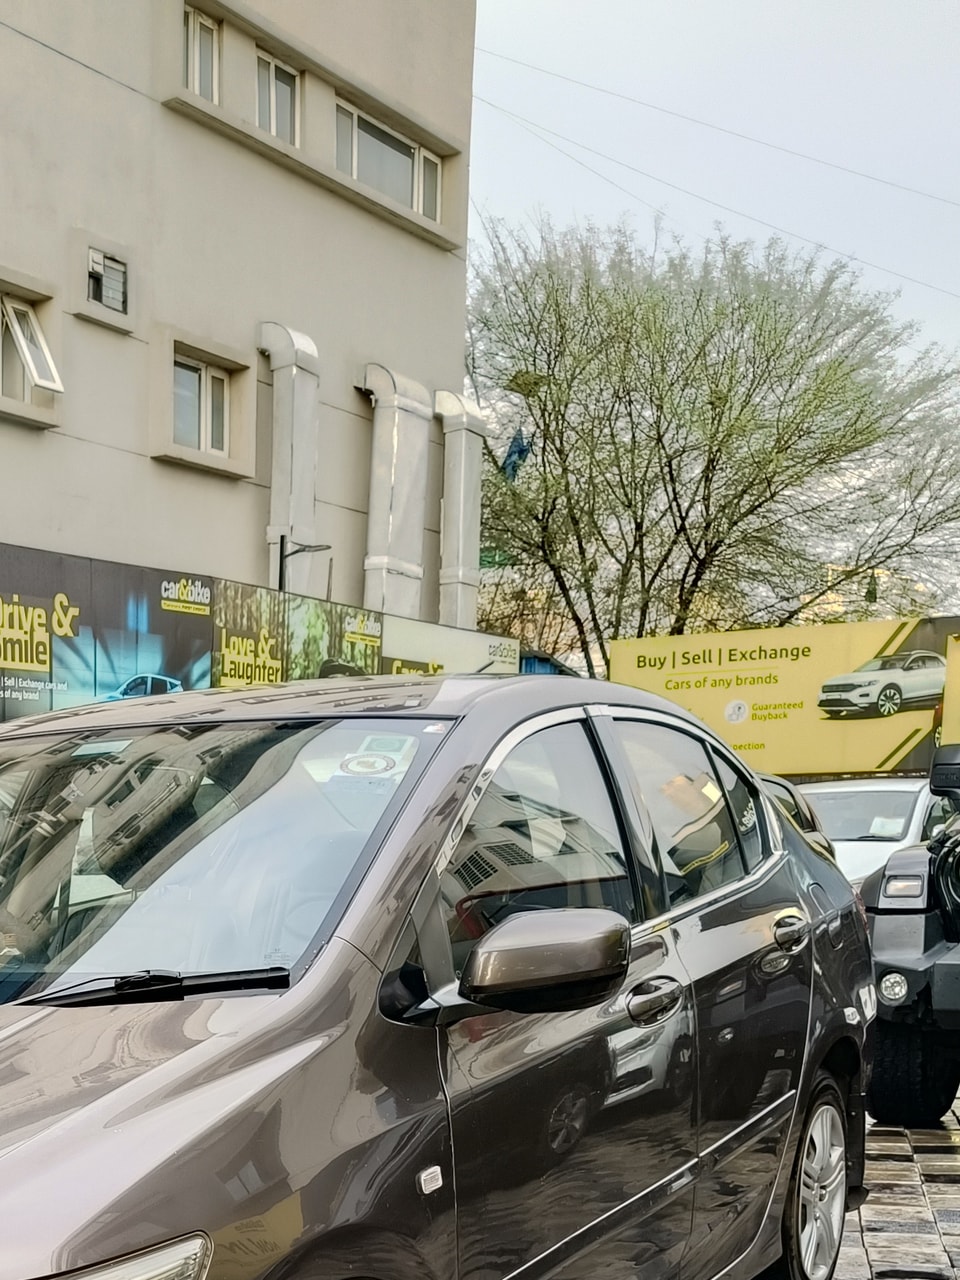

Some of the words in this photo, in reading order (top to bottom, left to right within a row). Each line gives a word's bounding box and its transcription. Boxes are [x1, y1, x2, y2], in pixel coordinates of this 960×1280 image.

[161, 578, 211, 604] car&bike
[52, 592, 80, 637] &
[221, 628, 255, 656] Love
[637, 655, 667, 670] Buy
[681, 649, 712, 665] Sell
[728, 645, 811, 663] Exchange
[221, 654, 280, 685] Laughter
[4, 676, 15, 686] Sell
[19, 677, 44, 690] Exchange
[57, 681, 68, 691] and
[665, 679, 691, 691] Cars
[694, 677, 707, 689] of
[711, 678, 732, 690] any
[735, 673, 779, 687] brands
[5, 688, 11, 698] of
[12, 690, 22, 701] any
[23, 689, 39, 700] brand
[751, 712, 788, 722] Buyback
[752, 701, 804, 712] Guaranteed
